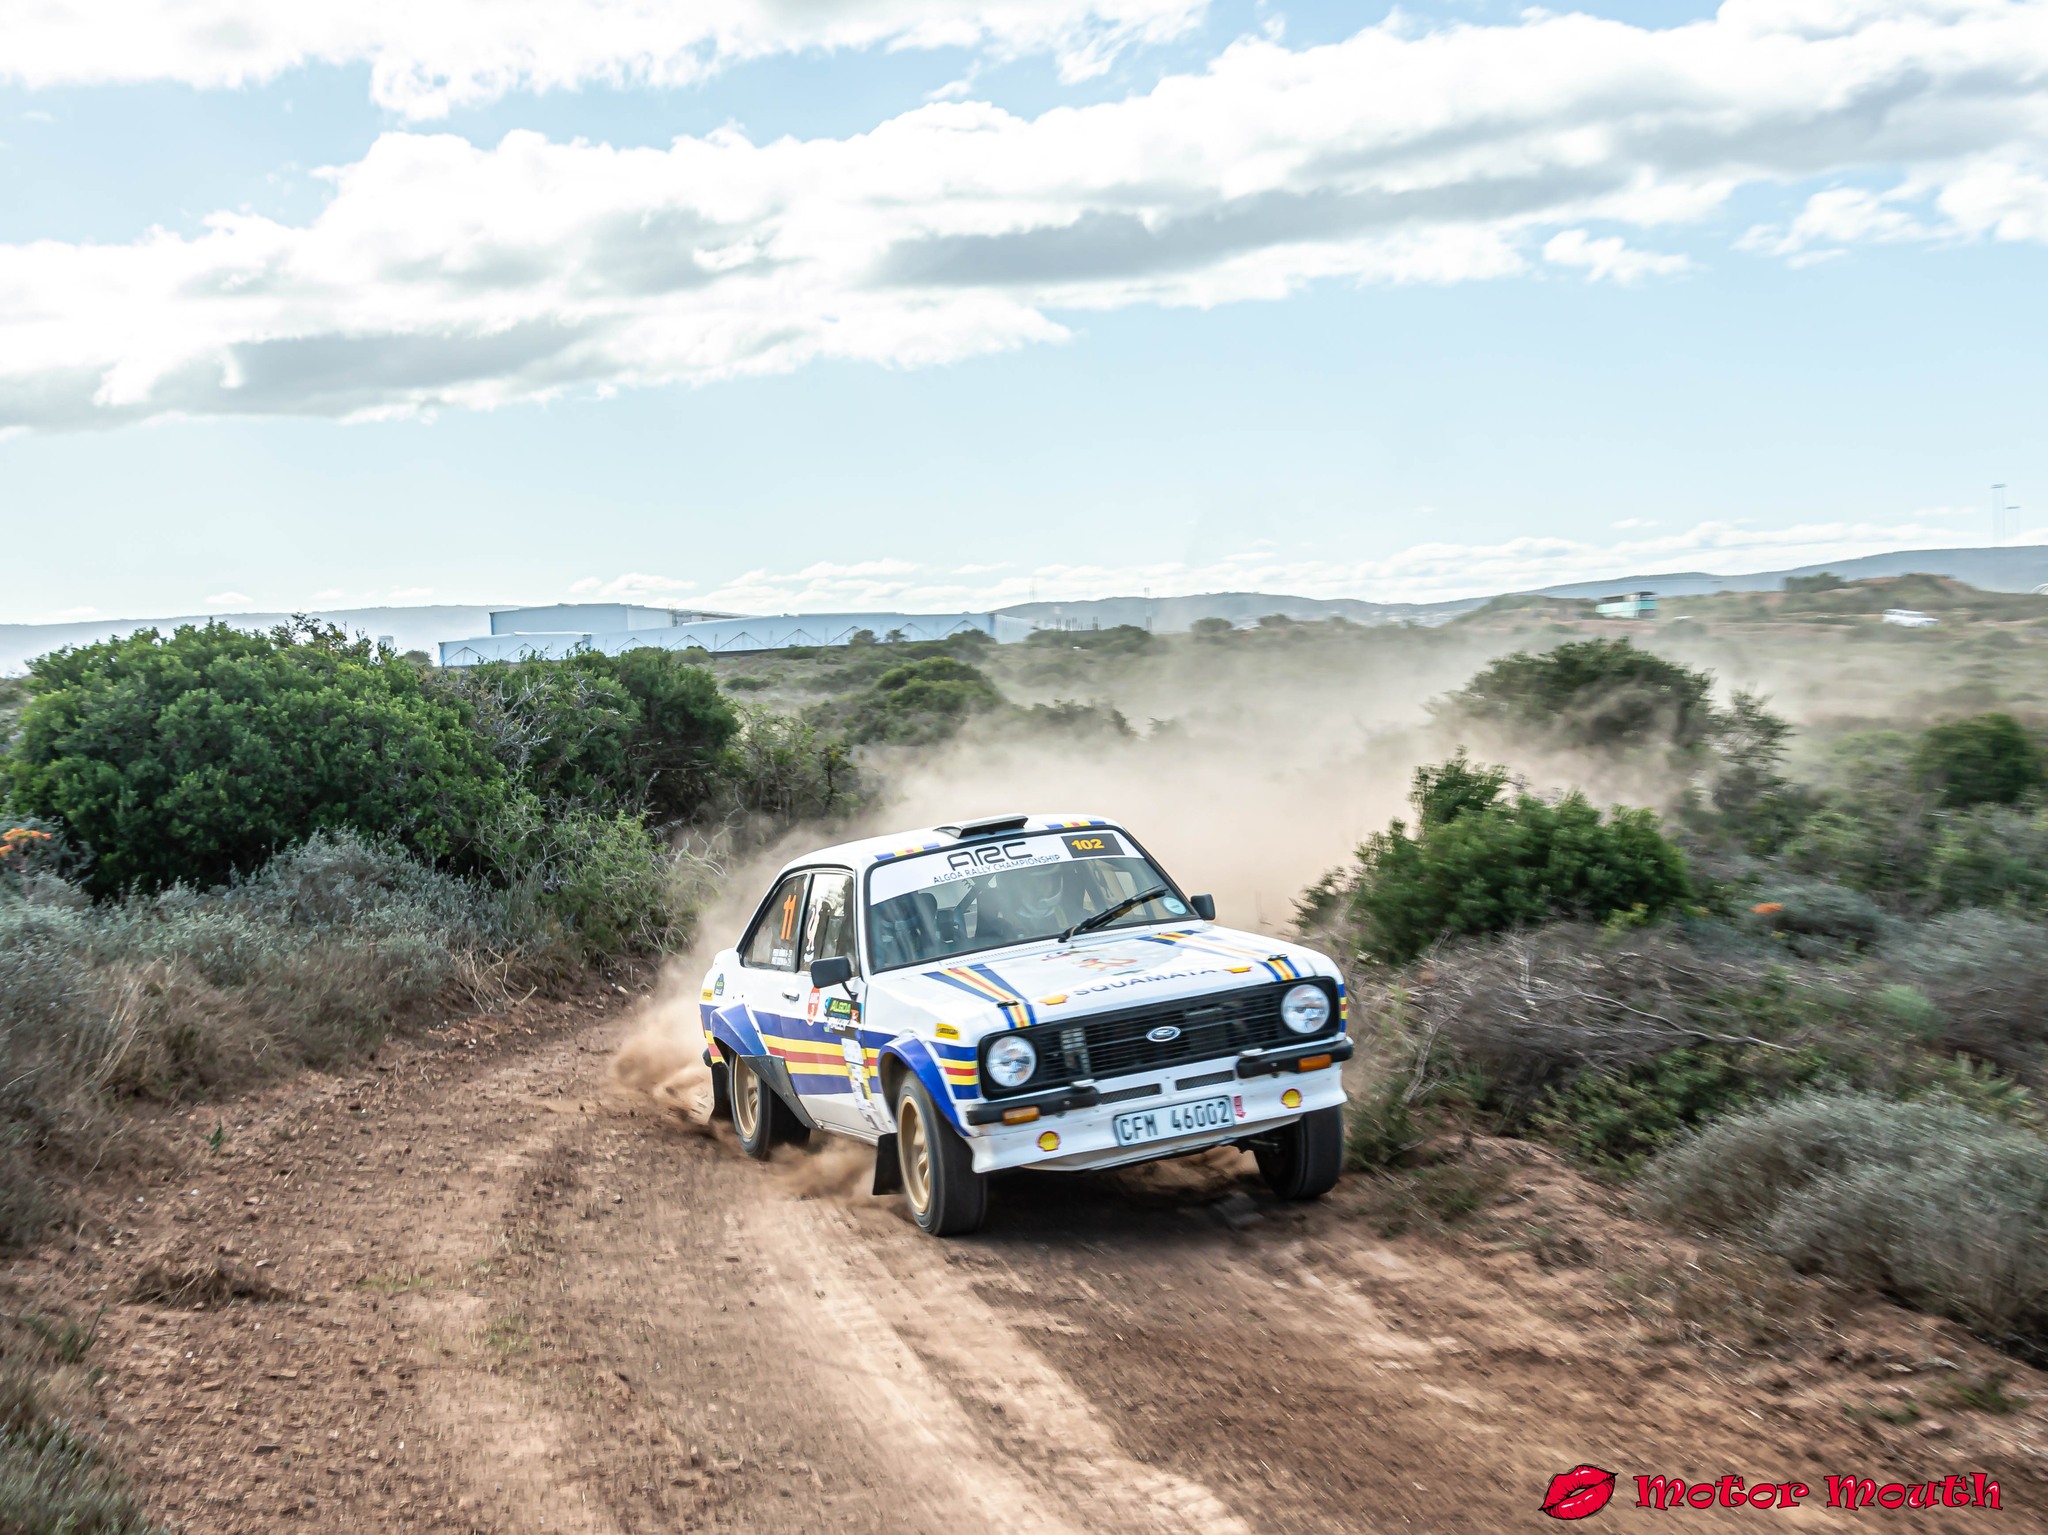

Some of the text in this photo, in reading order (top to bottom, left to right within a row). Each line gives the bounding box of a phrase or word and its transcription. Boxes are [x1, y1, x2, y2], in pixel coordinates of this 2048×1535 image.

[946, 841, 1033, 871] ARC
[1071, 838, 1105, 850] 102
[933, 854, 1061, 884] ALGOA RALLY CHAMPIONSHIP
[781, 894, 797, 940] 11
[1074, 968, 1218, 996] SQUAMATA
[1119, 1113, 1158, 1141] CFM
[1171, 1101, 1231, 1132] 46002
